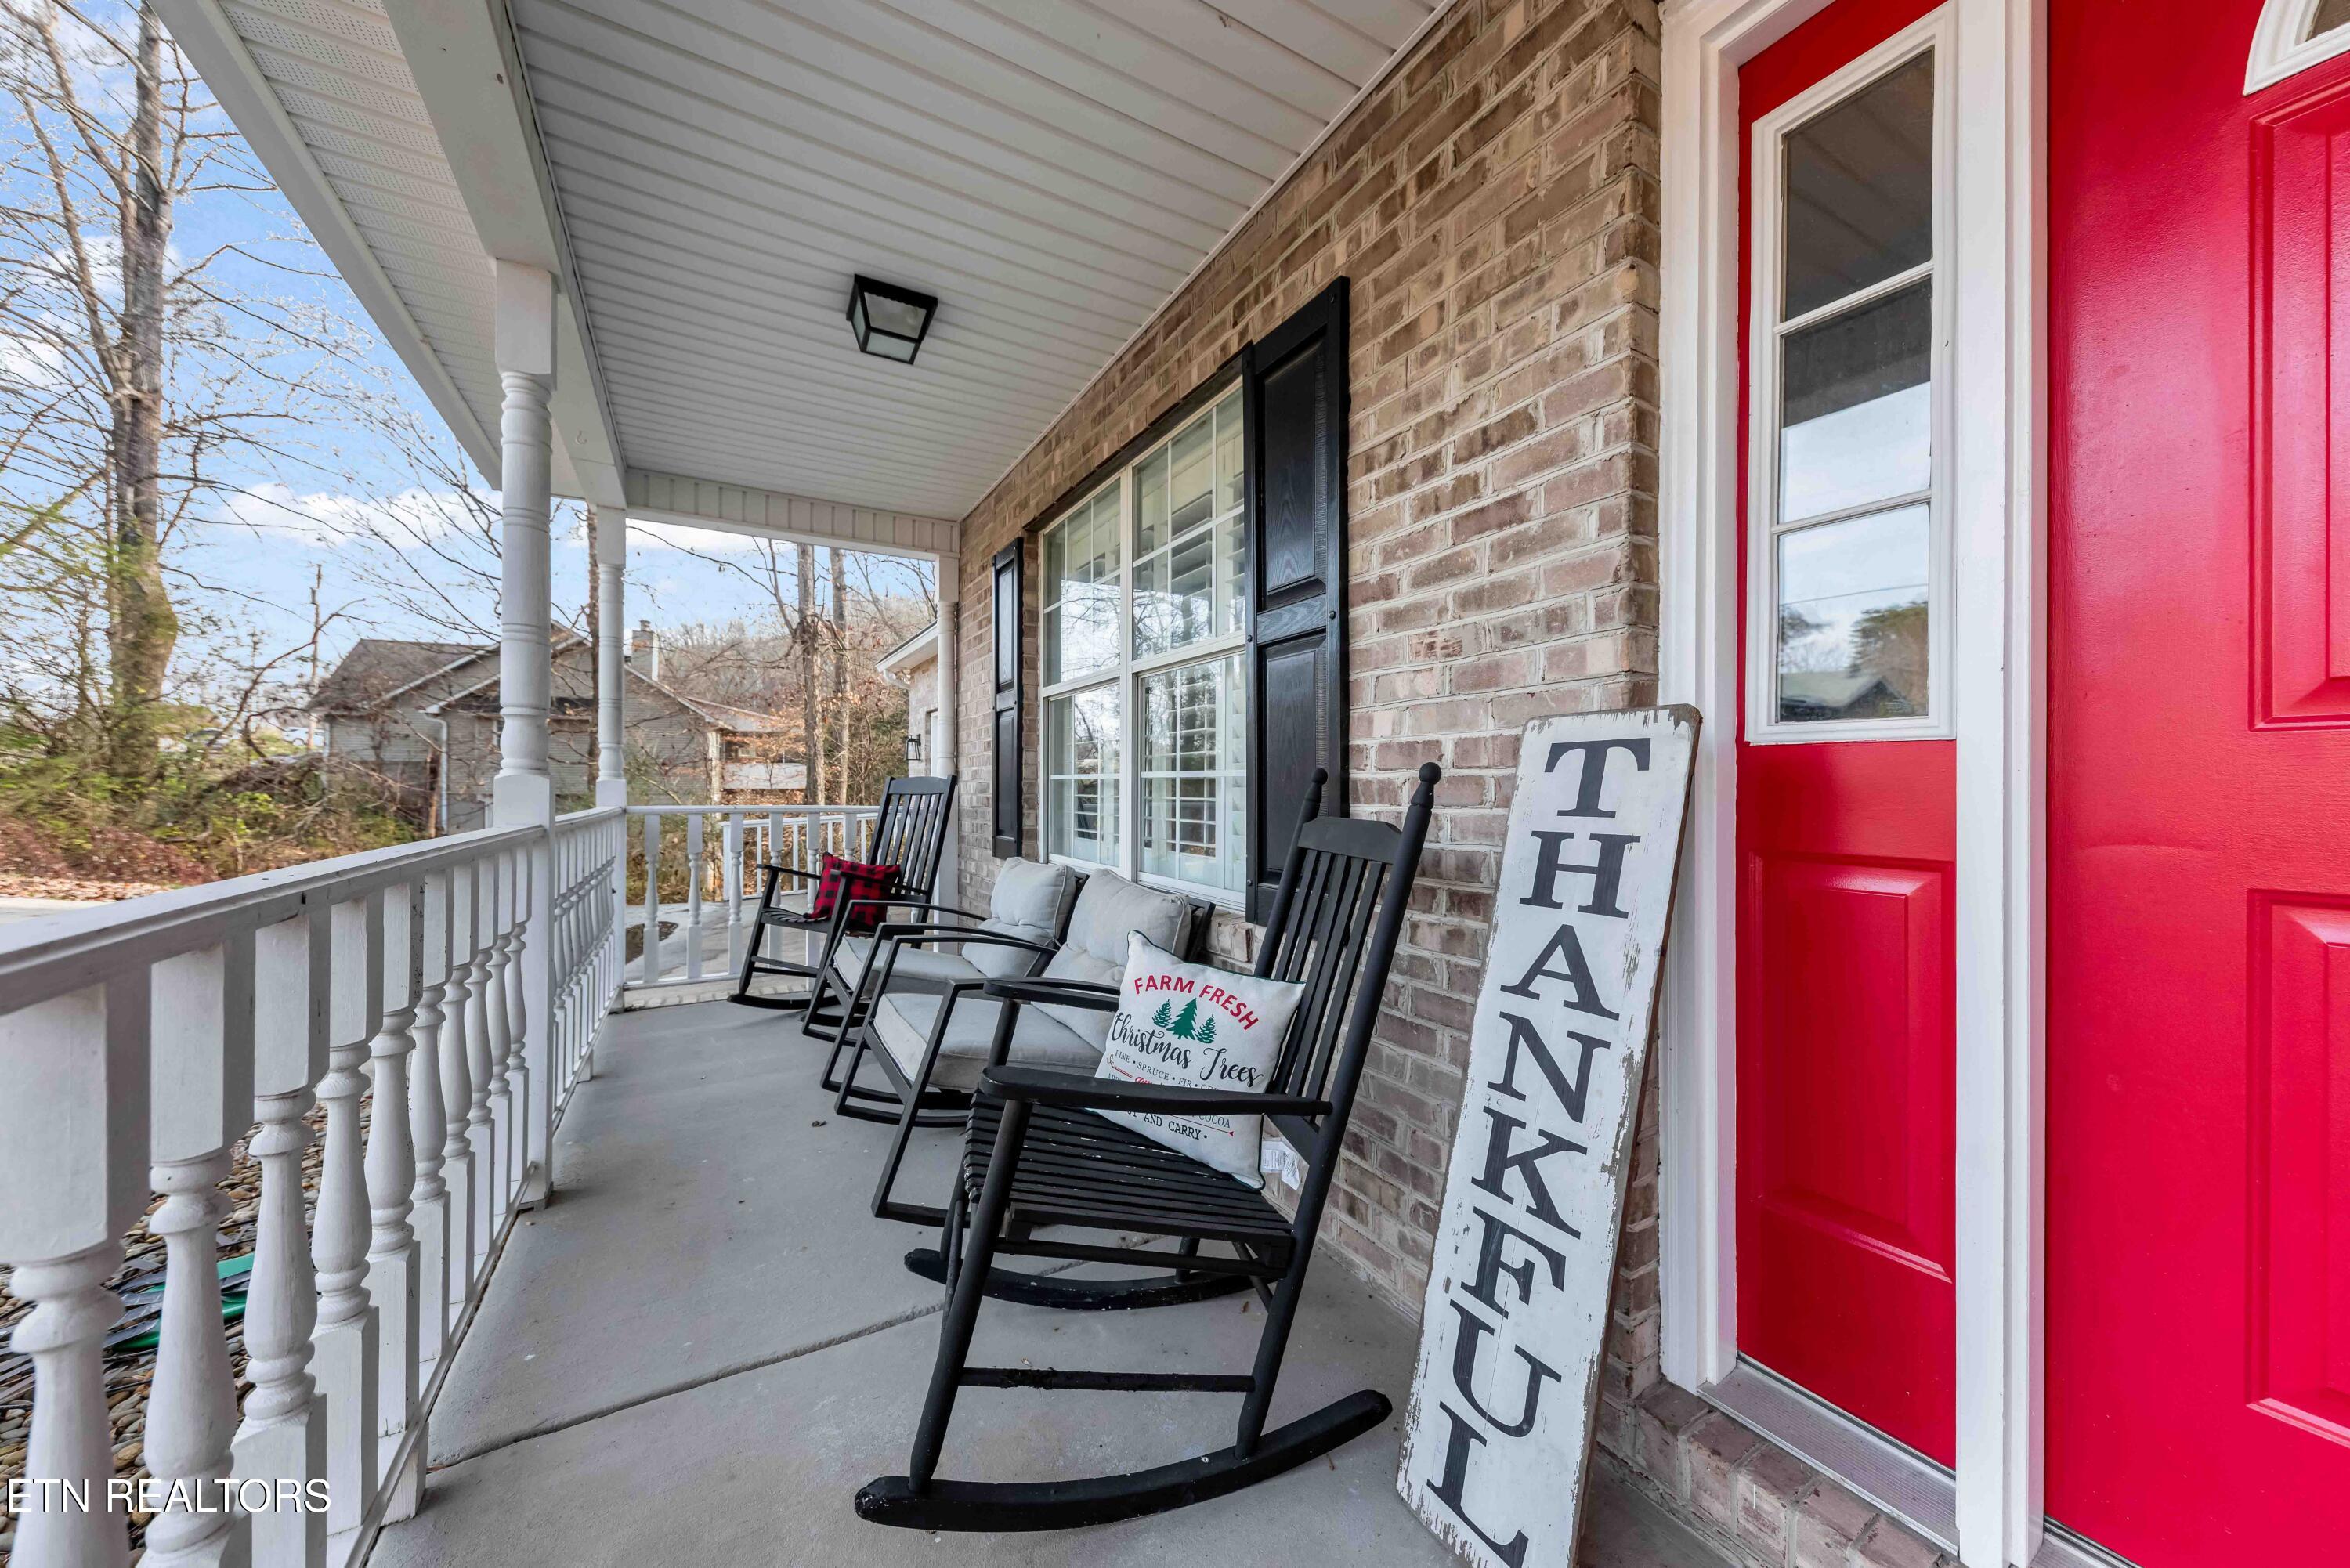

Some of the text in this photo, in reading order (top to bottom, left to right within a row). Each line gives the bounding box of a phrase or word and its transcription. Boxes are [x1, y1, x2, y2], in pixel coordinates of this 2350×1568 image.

[1134, 975, 1259, 1031] FARM FRESH
[1112, 1012, 1264, 1087] Christmas Trees
[1115, 1050, 1130, 1064] PINE
[1137, 1061, 1170, 1081] SPRUCE
[1178, 1077, 1192, 1089] FIR
[1144, 1112, 1162, 1126] AND
[1168, 1121, 1202, 1140] CARRY
[1426, 738, 1650, 1568] THANKFUL
